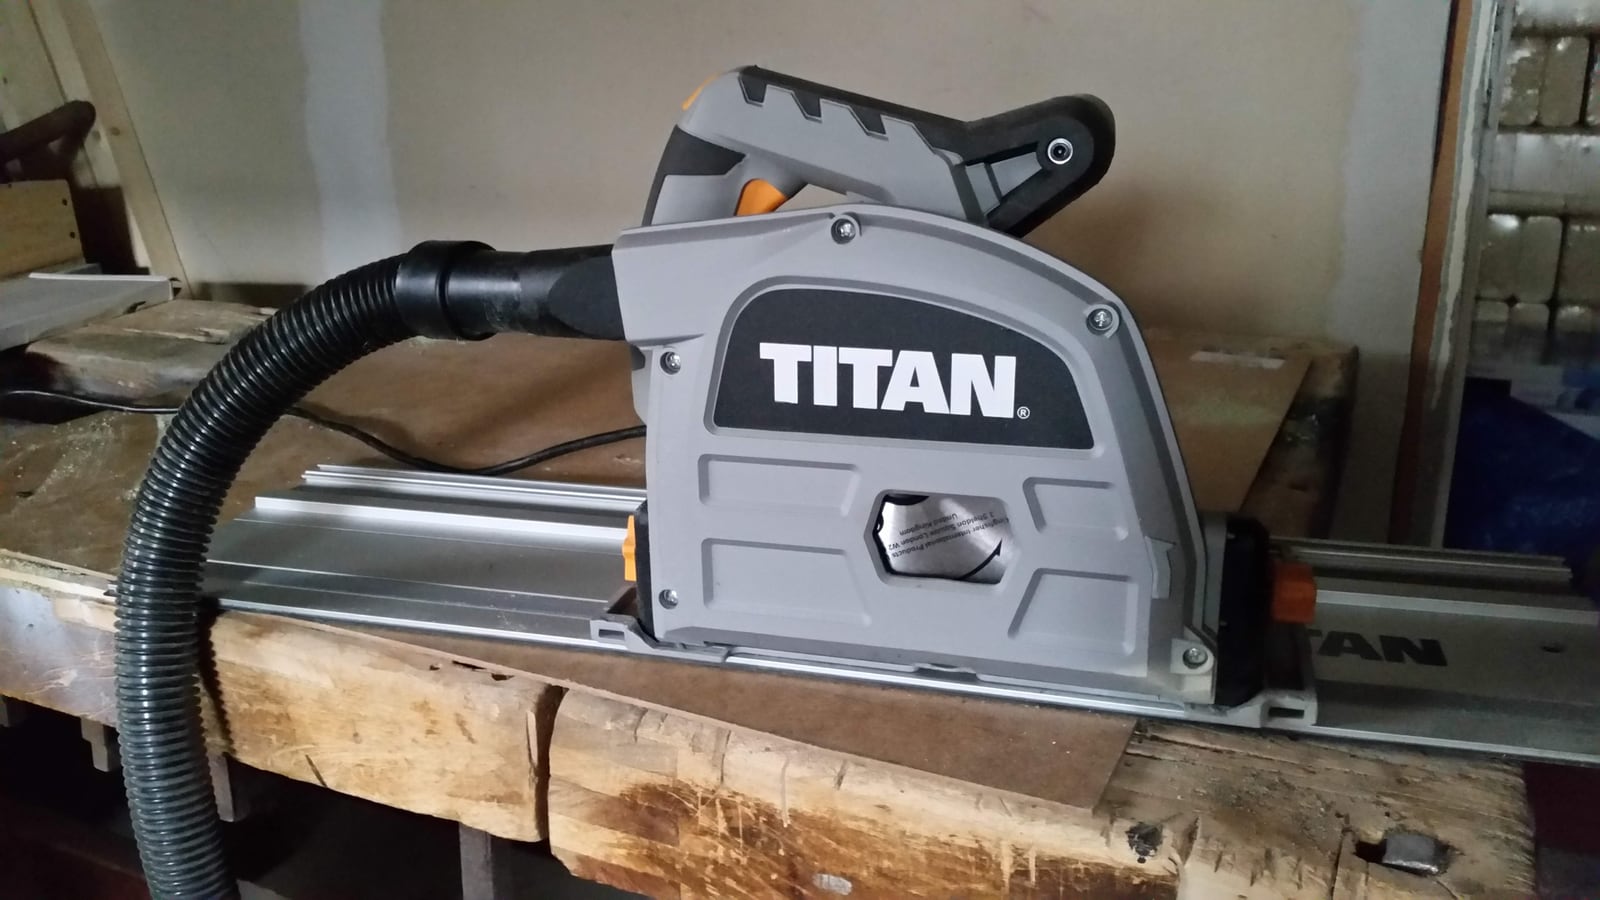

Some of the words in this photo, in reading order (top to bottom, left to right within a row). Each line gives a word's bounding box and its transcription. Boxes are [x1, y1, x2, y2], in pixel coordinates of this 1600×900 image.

[759, 342, 1017, 418] TITAN
[934, 512, 958, 526] United
[957, 513, 989, 528] Sheldon
[900, 521, 933, 536] Kingdom
[901, 532, 930, 546] London
[925, 530, 971, 549] International
[892, 544, 924, 558] Products
